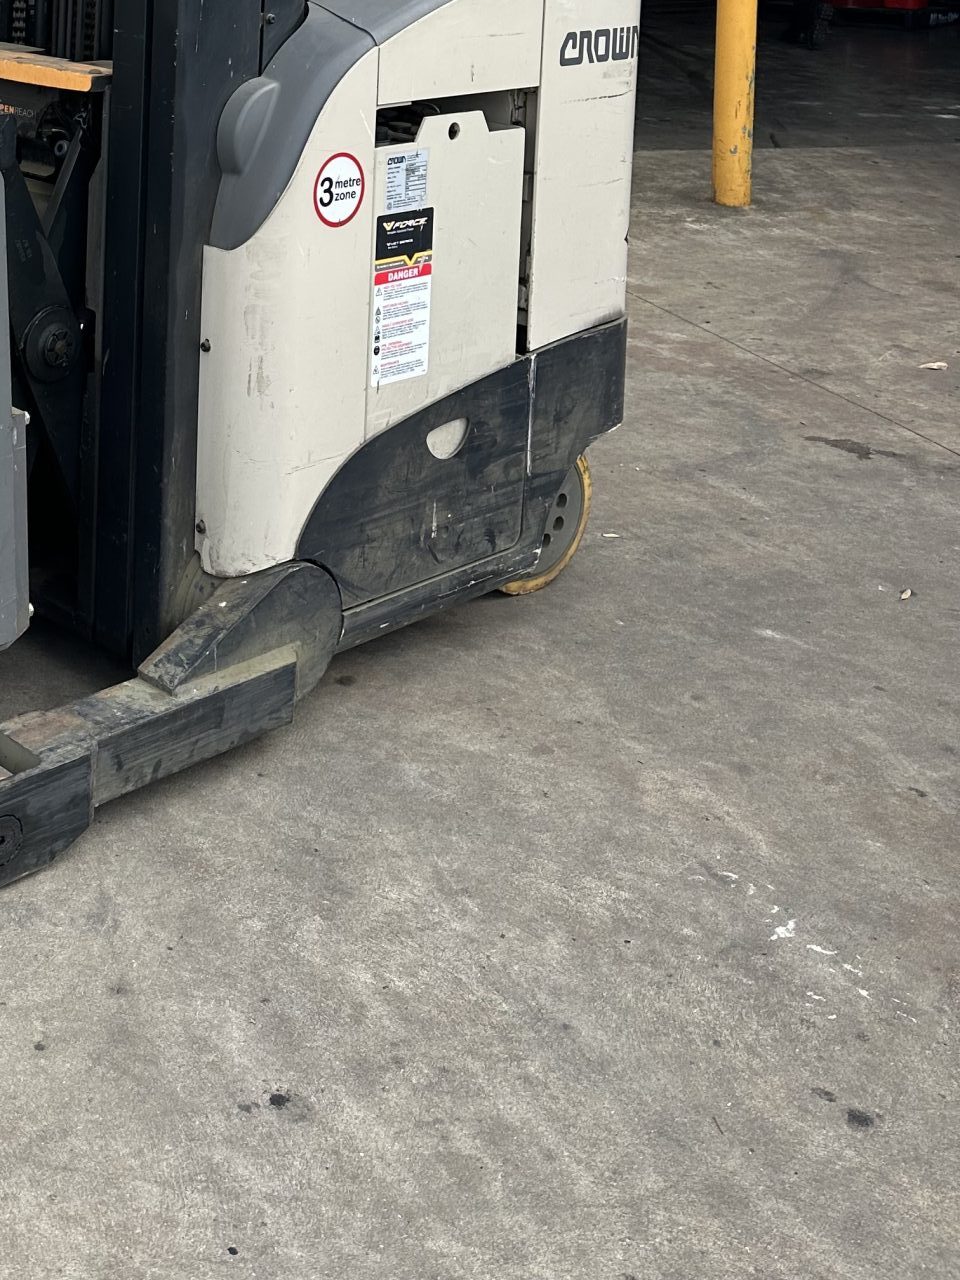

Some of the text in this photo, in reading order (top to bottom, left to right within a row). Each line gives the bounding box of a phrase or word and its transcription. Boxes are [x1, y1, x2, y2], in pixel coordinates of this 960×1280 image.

[559, 25, 640, 67] CROWN
[319, 177, 361, 207] 3 metre
[334, 190, 357, 201] zone
[387, 267, 419, 282] DANGER
